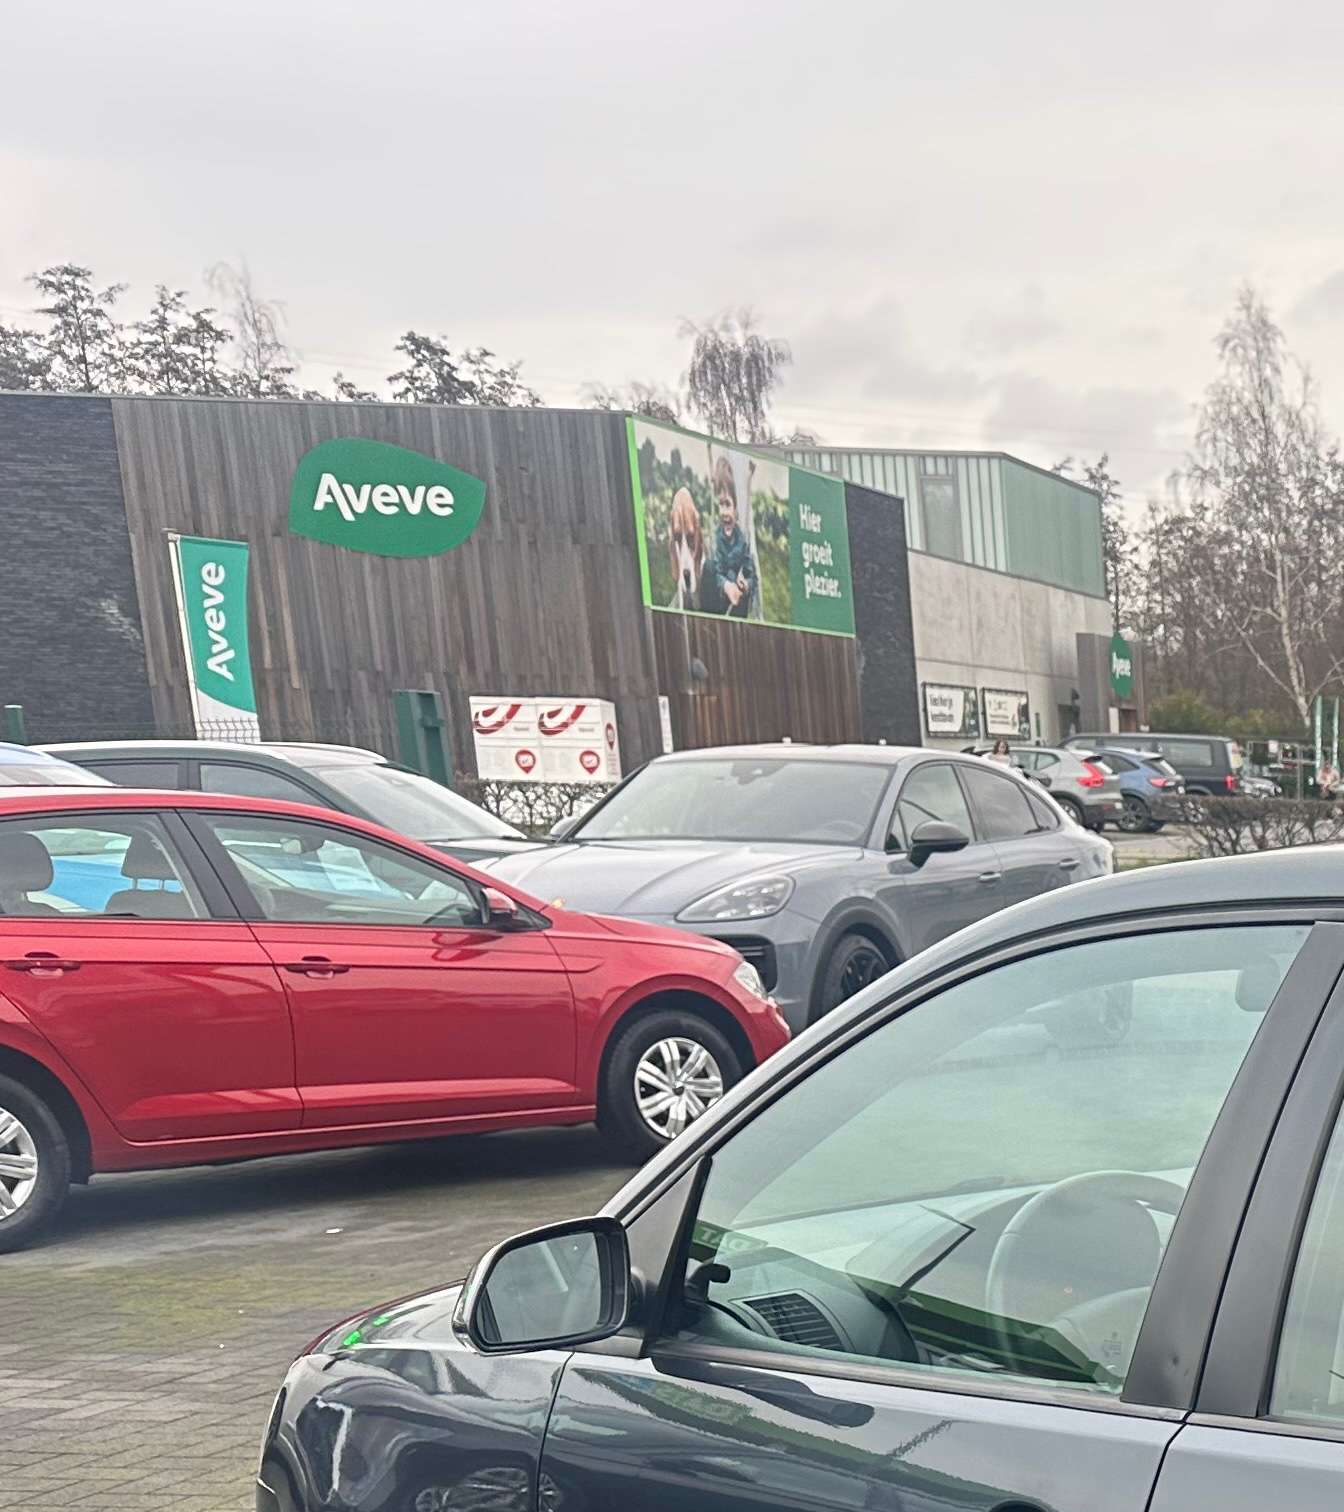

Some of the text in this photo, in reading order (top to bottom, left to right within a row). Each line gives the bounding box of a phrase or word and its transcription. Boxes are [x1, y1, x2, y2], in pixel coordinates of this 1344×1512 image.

[313, 473, 455, 522] Aveve
[799, 503, 821, 533] Hier
[802, 540, 833, 568] groeit
[804, 568, 842, 599] plezier.
[202, 562, 236, 682] Aveve
